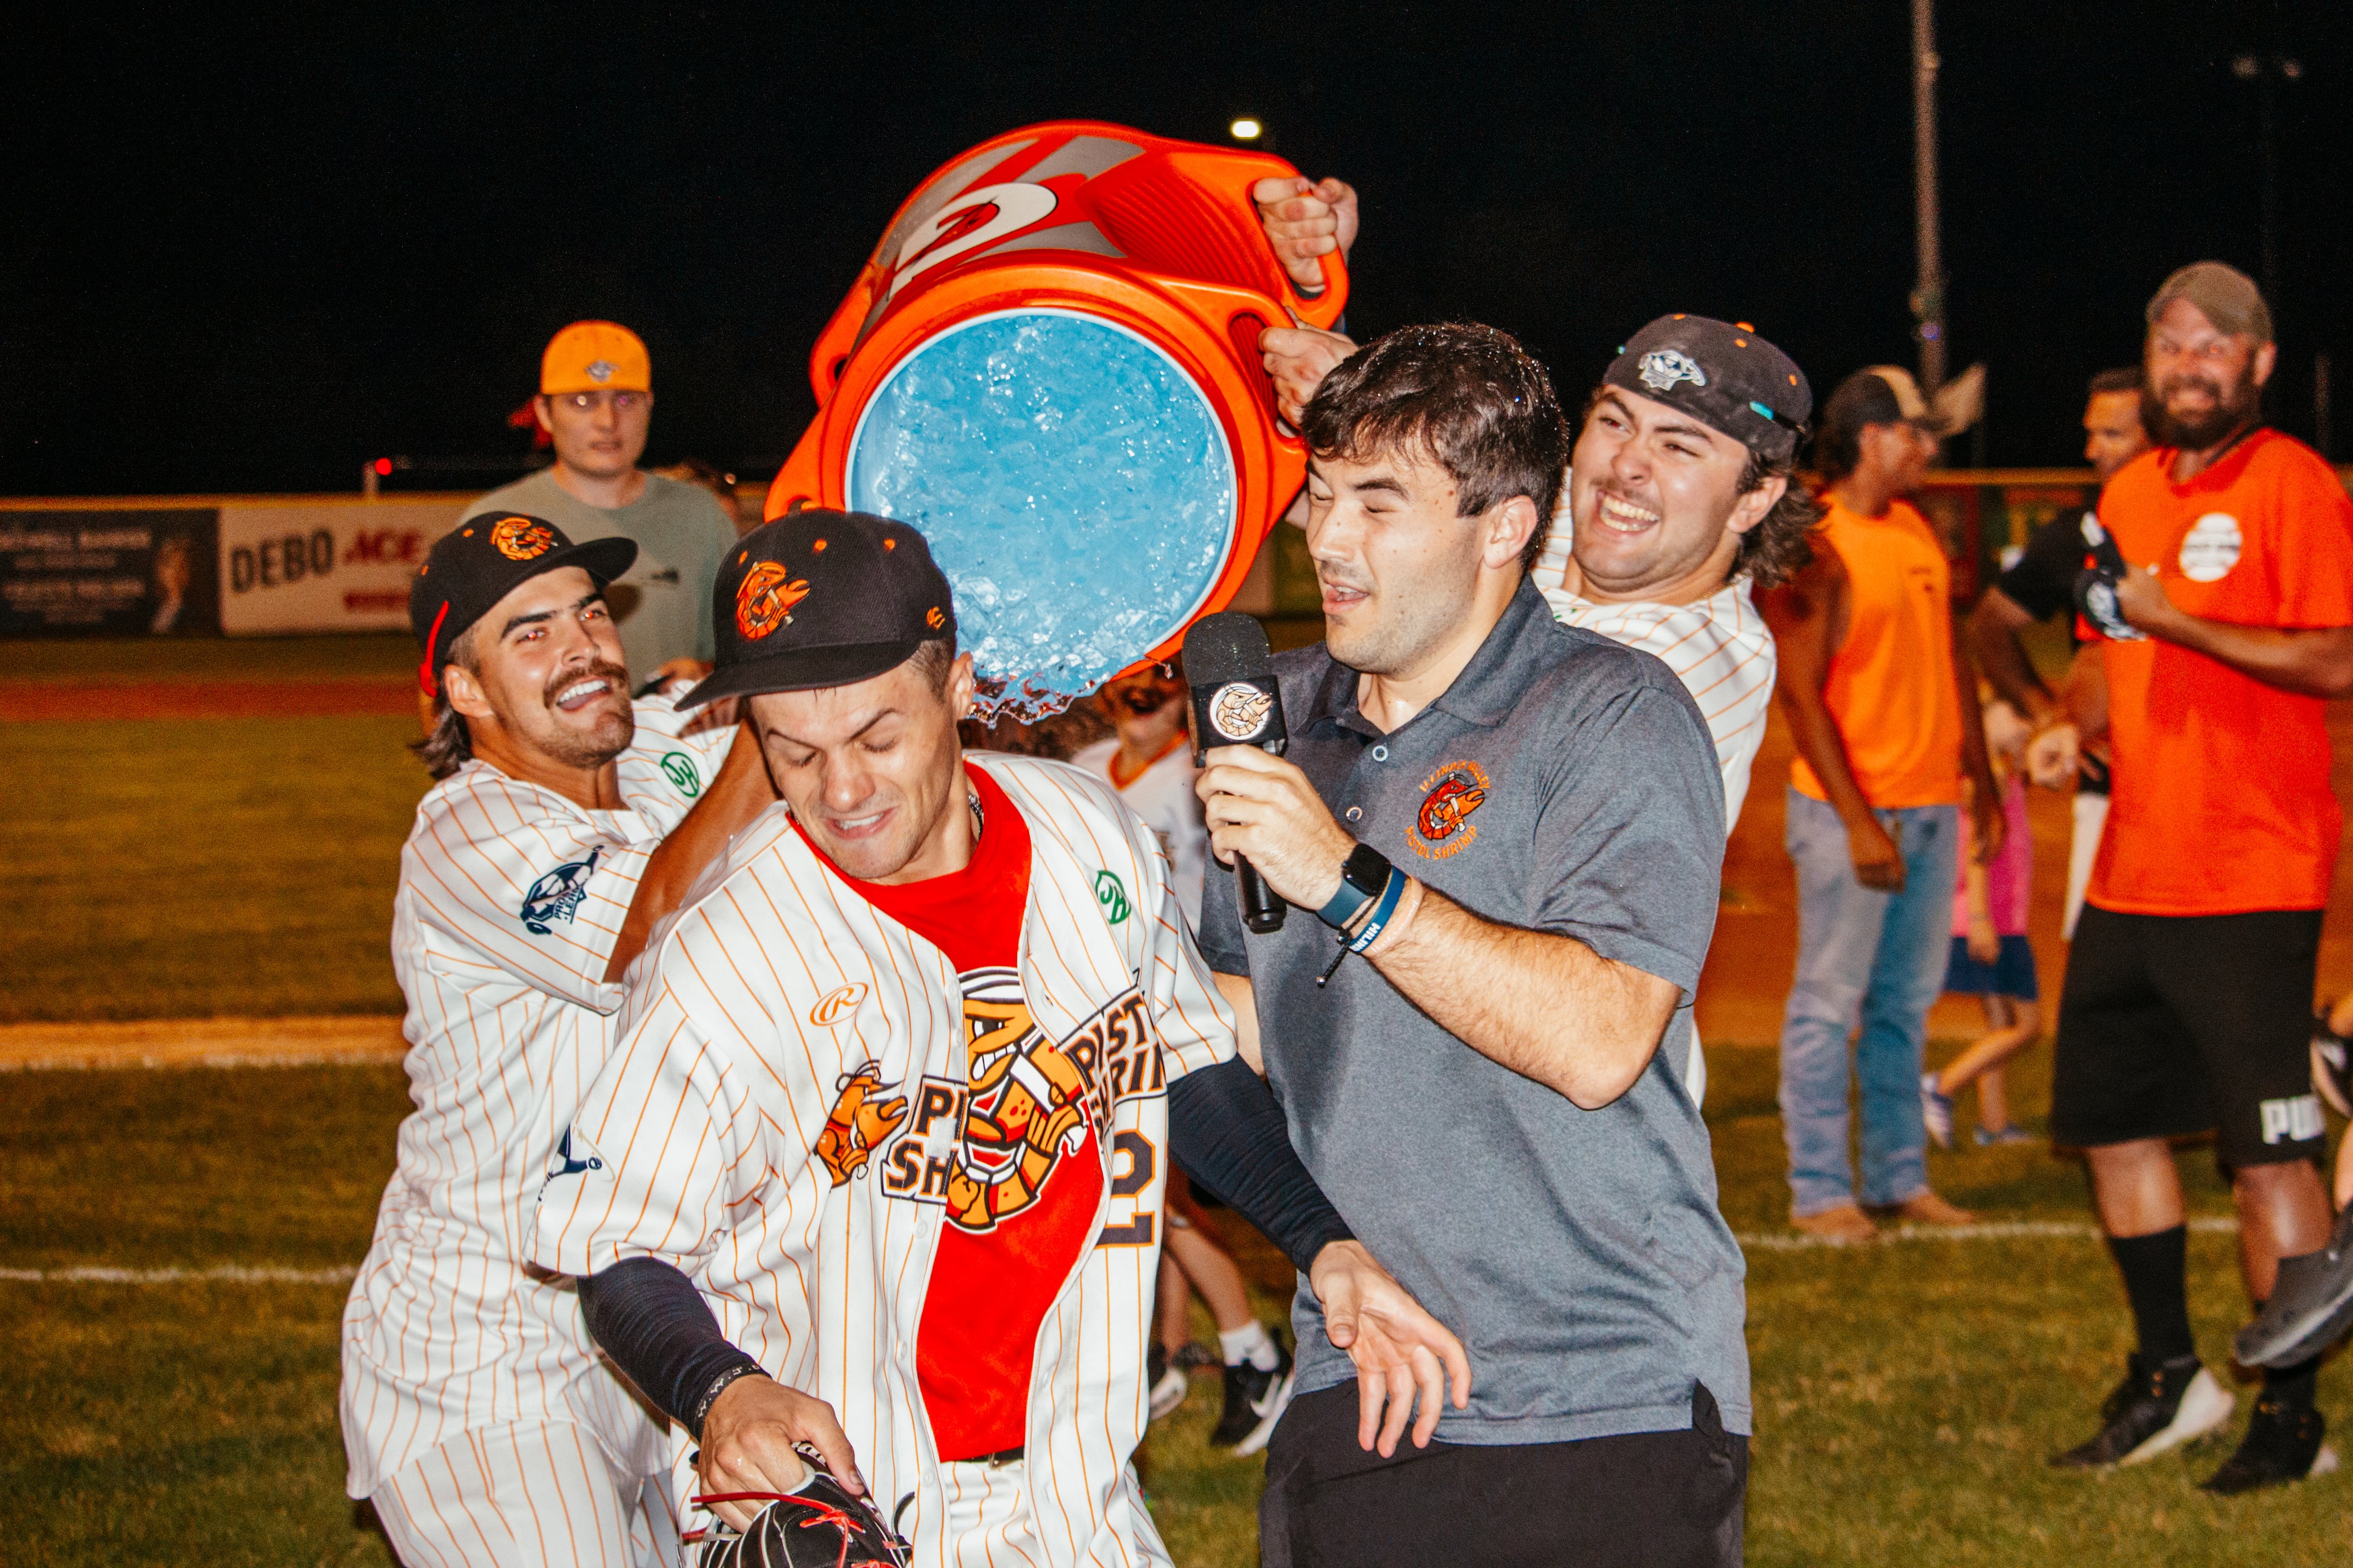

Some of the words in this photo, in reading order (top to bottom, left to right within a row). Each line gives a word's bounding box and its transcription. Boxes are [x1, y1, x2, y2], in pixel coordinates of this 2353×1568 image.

[231, 527, 334, 593] DEBO
[1433, 825, 1478, 860] SHRIMP
[2260, 1095, 2324, 1145] PU
